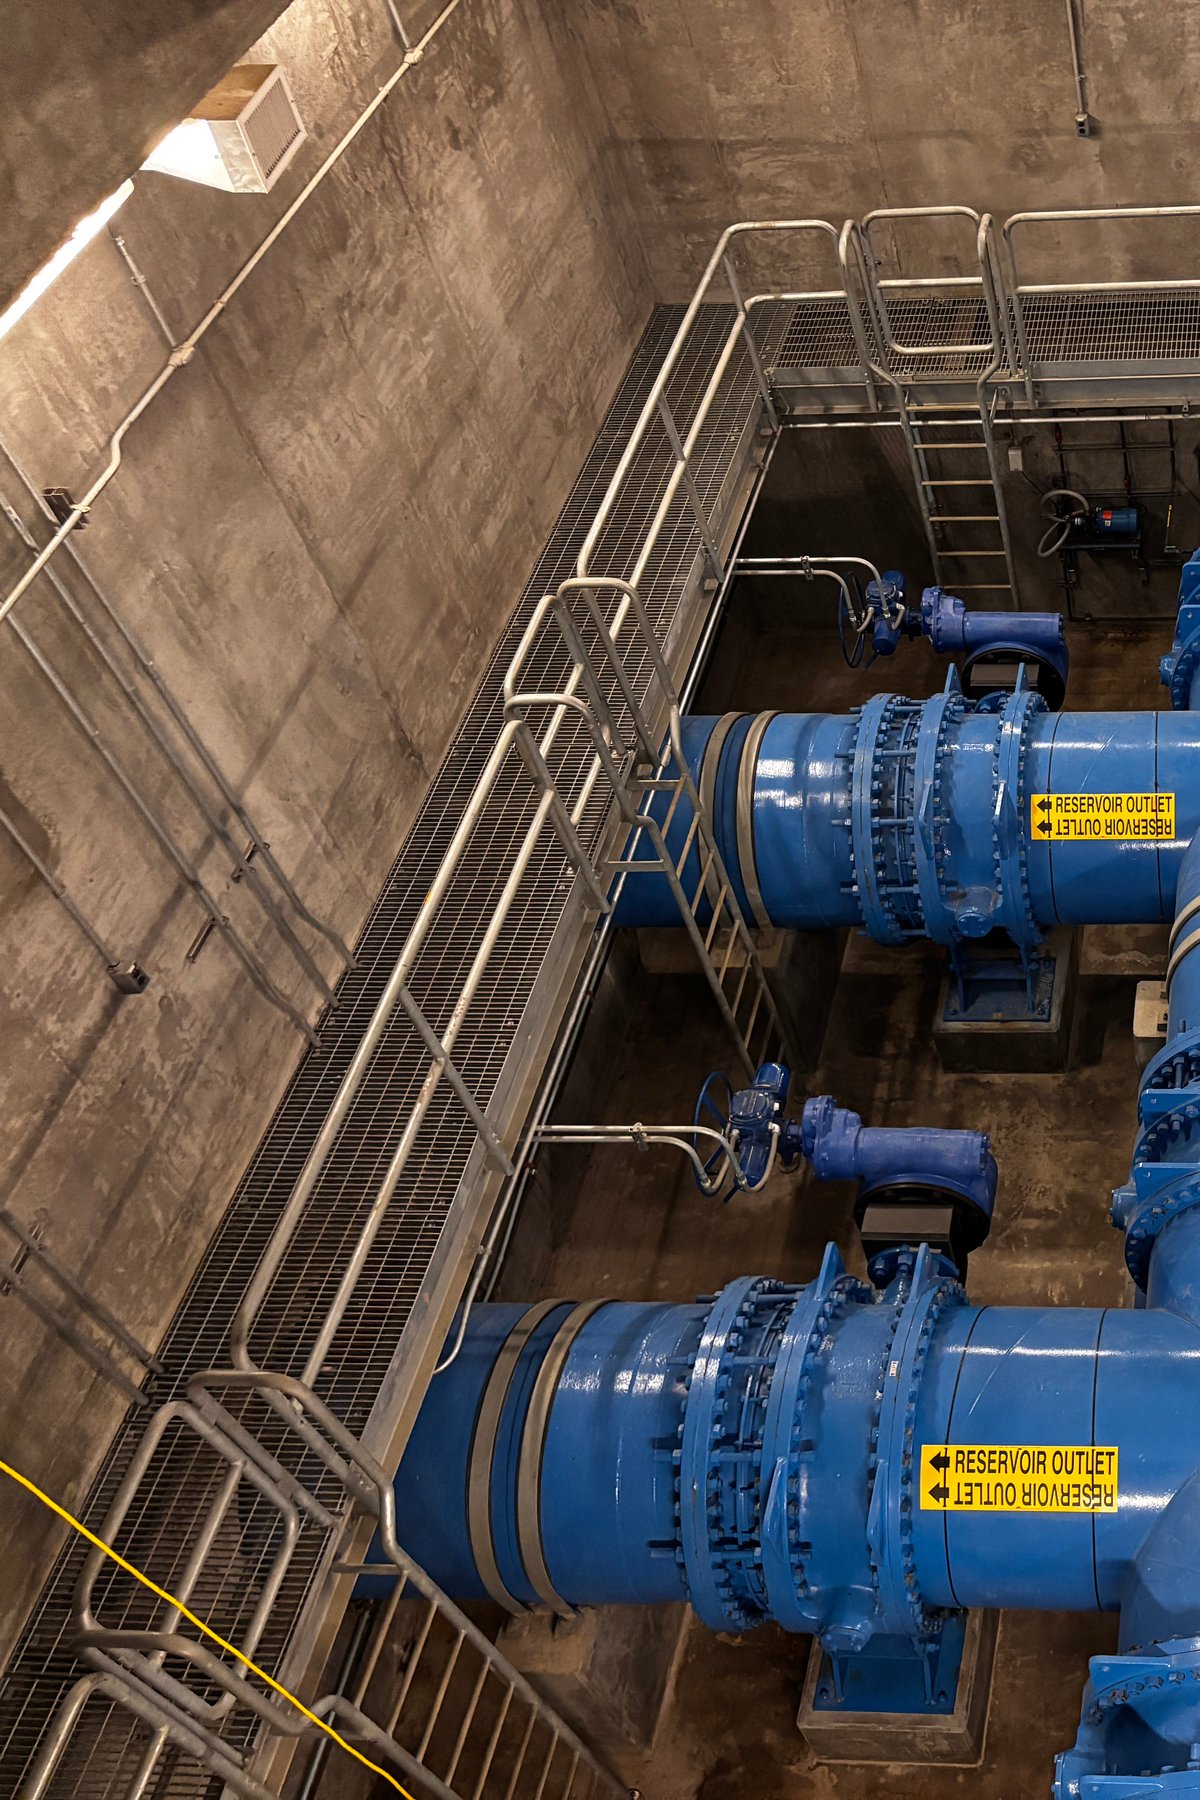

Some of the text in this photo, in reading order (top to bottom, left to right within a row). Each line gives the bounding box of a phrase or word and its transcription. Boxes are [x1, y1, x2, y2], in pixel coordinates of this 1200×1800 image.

[1055, 796, 1173, 813] RESERVOIR OUTLET
[1055, 818, 1172, 836] RESERVOIR OUTLET
[955, 1449, 1115, 1475] RESERVOIR OUTLET
[953, 1482, 1114, 1507] RESERVOIR OUTLET
